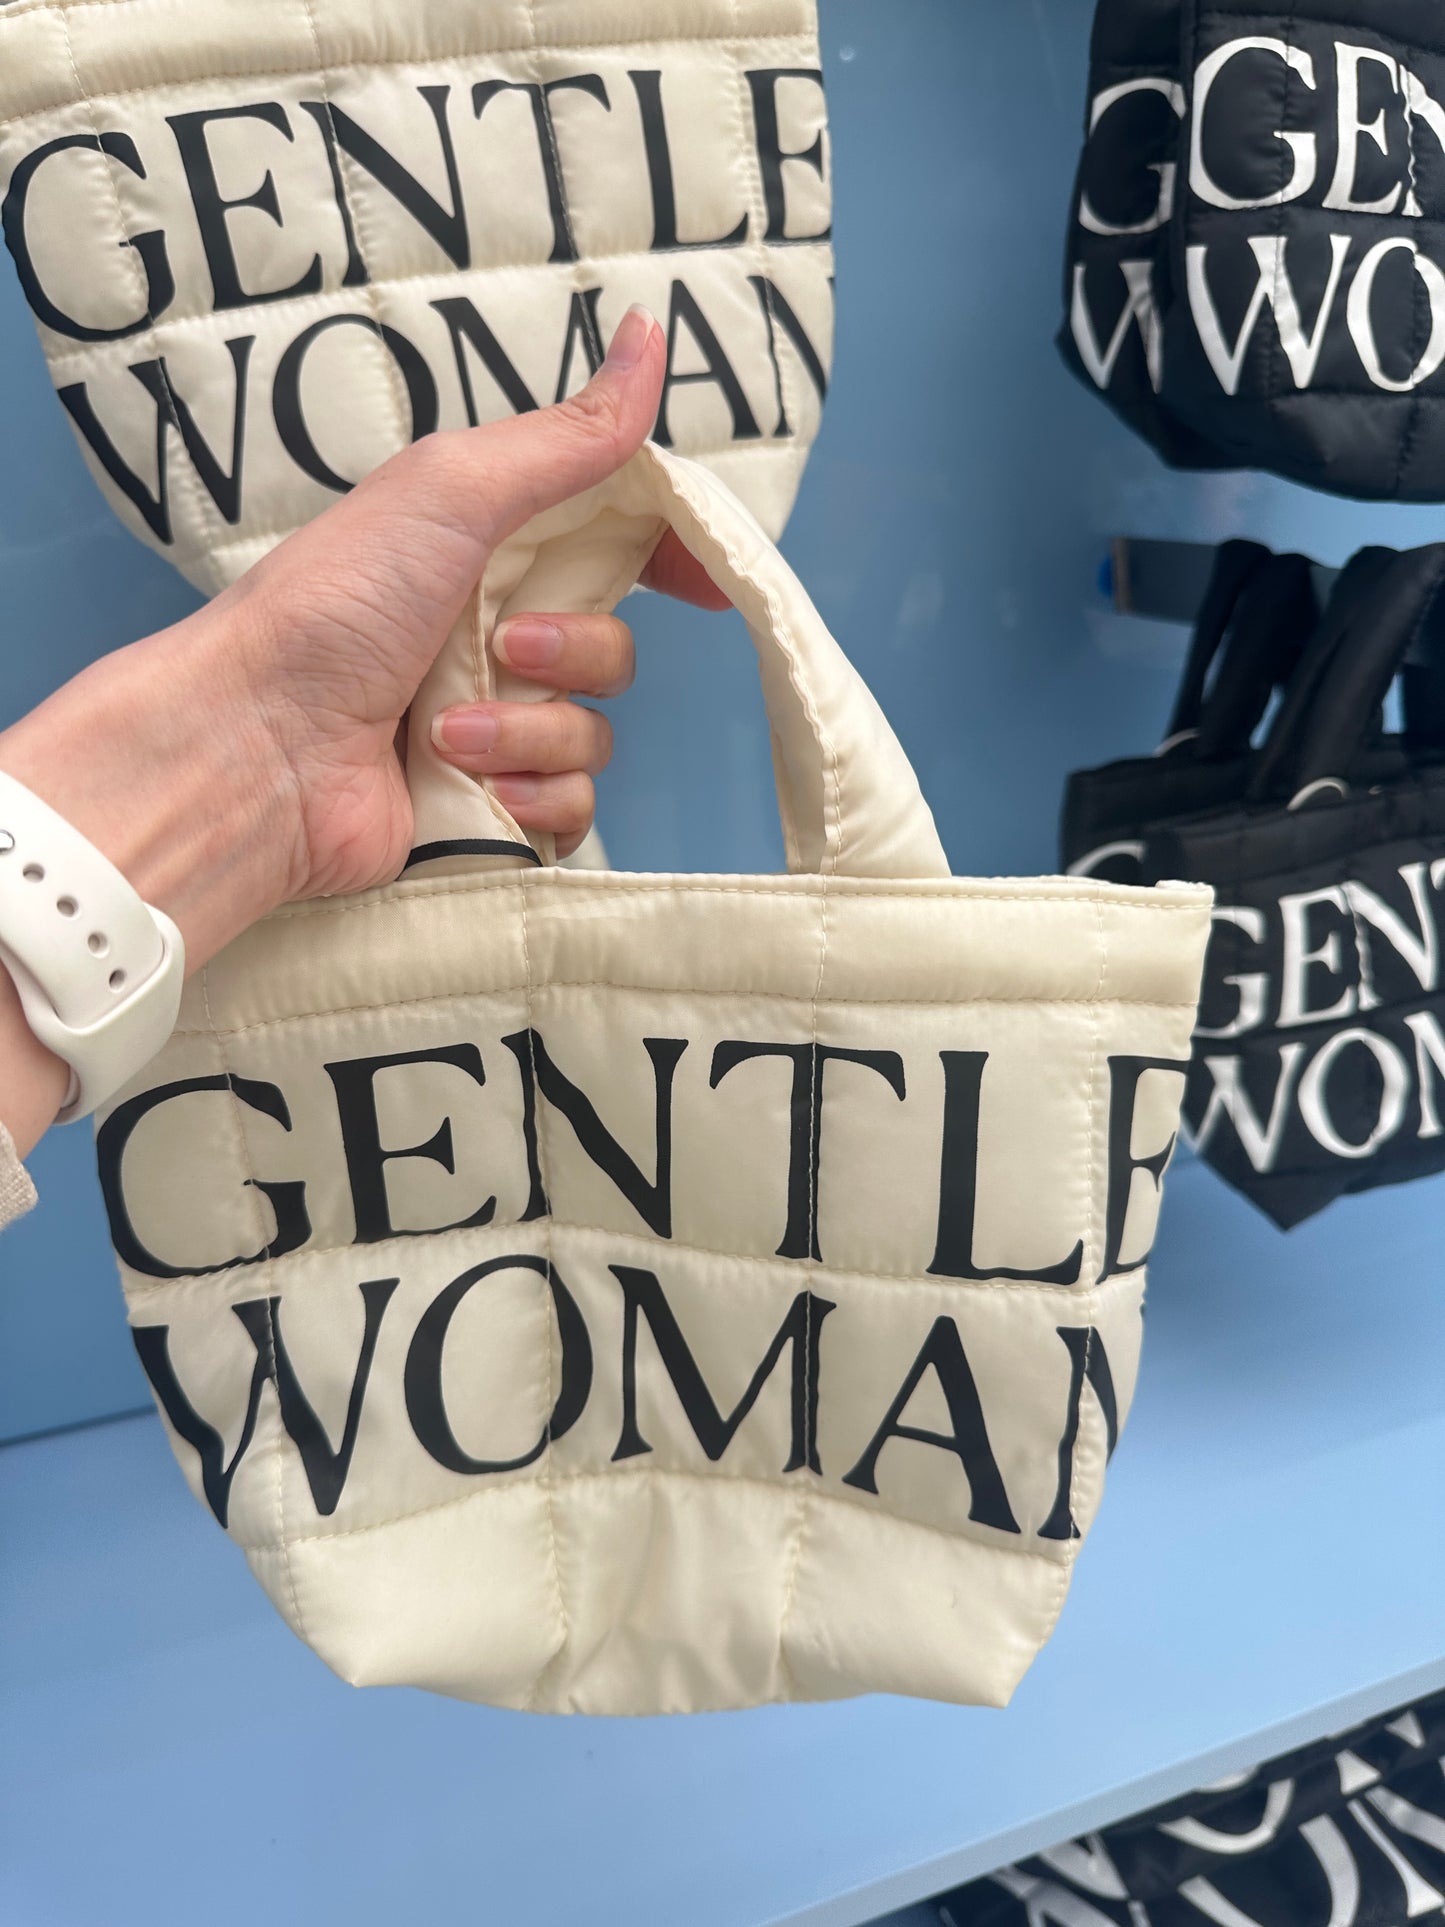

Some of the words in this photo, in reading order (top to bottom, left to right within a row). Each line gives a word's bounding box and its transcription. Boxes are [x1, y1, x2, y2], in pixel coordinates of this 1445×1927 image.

[3, 69, 833, 341] GENTLE
[1186, 234, 1445, 396] WO
[56, 273, 836, 546] WOMAN
[1192, 857, 1445, 1040] GEN
[96, 1027, 1190, 1287] GENTLE
[129, 1252, 1120, 1562] WOMAN
